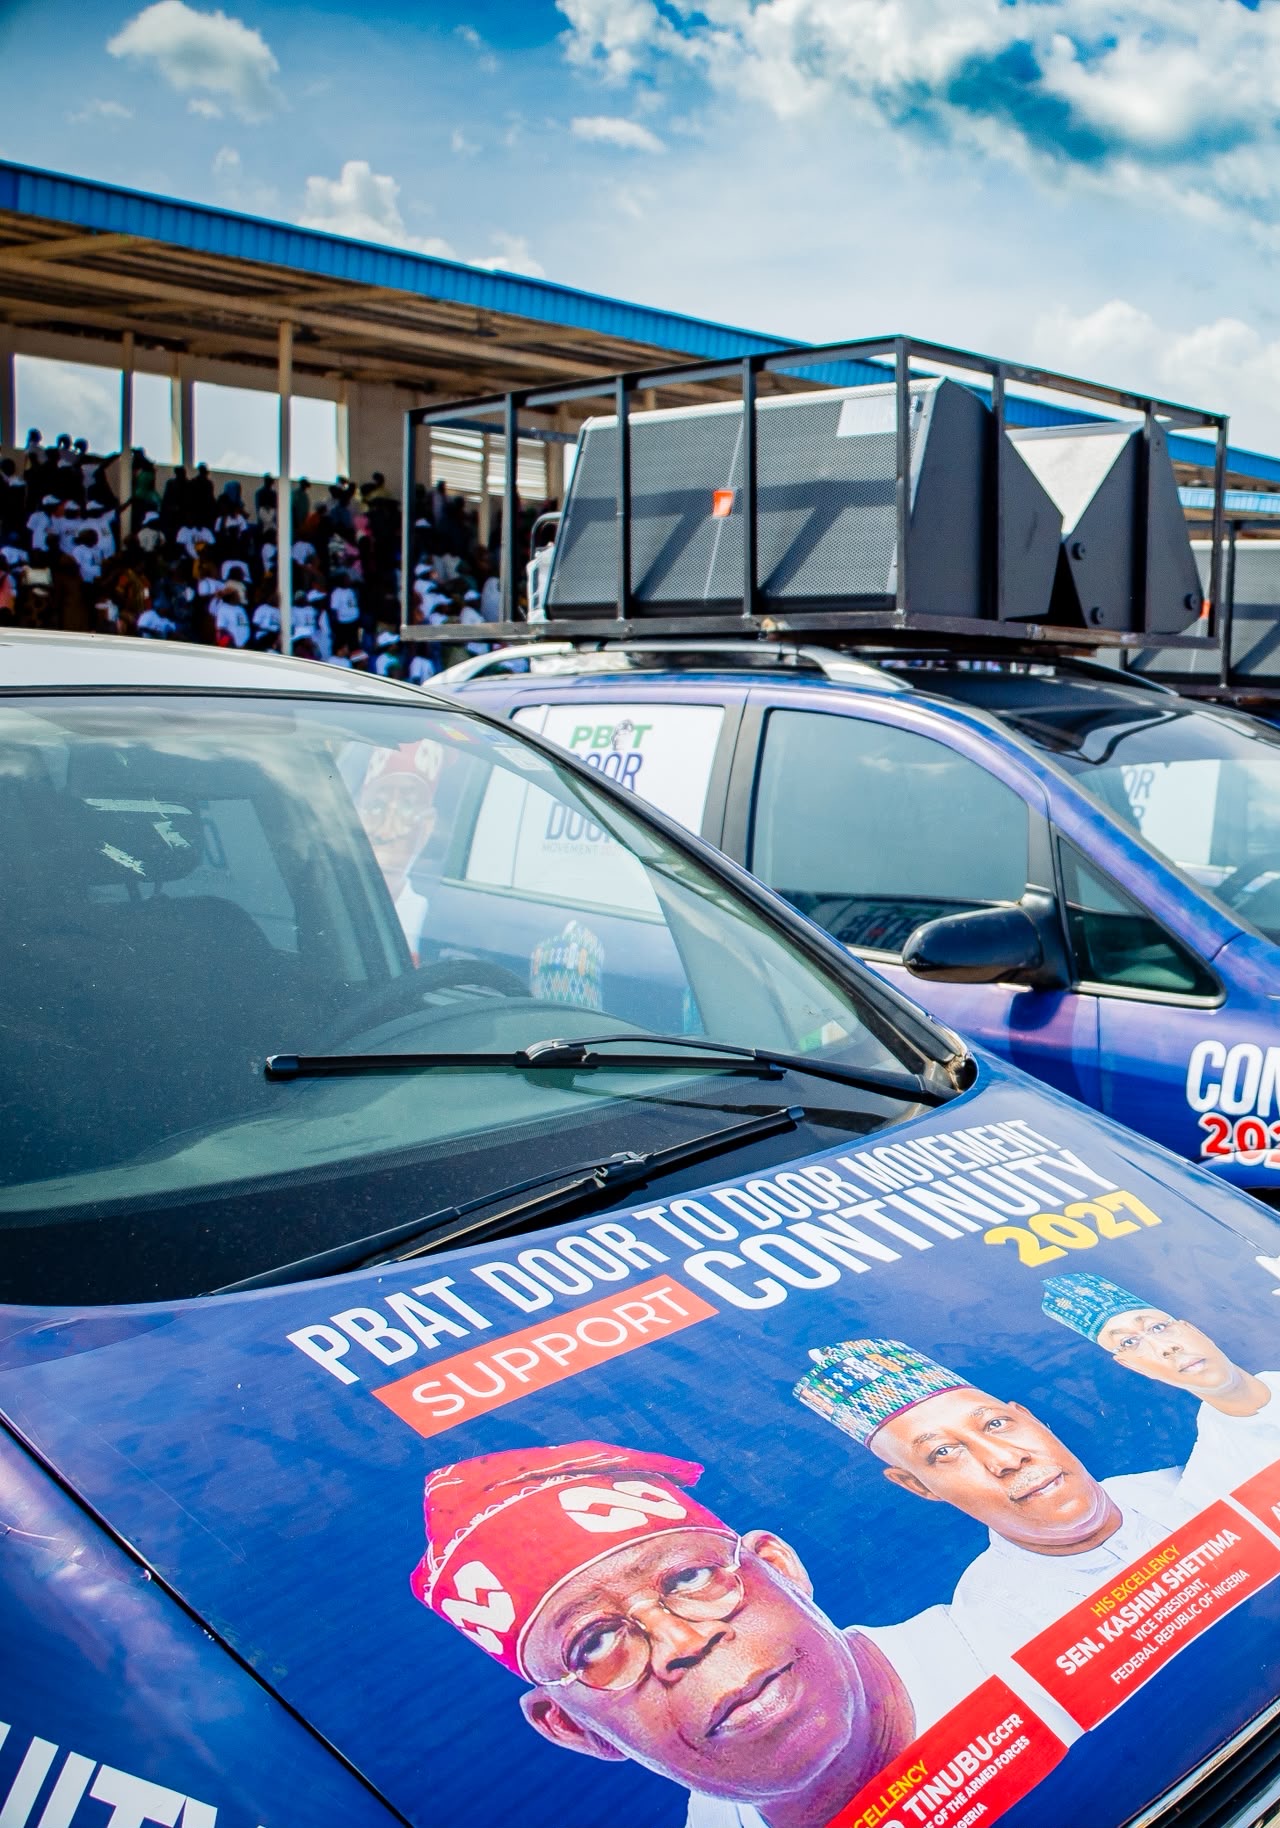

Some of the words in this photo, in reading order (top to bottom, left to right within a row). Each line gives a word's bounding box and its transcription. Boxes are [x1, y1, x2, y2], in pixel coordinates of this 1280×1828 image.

[569, 721, 653, 749] PBT
[286, 1276, 493, 1385] PBAT
[471, 1223, 671, 1314] DOOR
[632, 1199, 739, 1250] TO
[710, 1165, 865, 1230] DOOR
[837, 1119, 1062, 1193] MOVEMENT
[984, 1190, 1163, 1267] 2027
[412, 1287, 691, 1418] SUPPORT
[684, 1149, 1120, 1310] CONTINUITY
[1055, 1636, 1105, 1675] SEN.
[1097, 1582, 1168, 1643] KASHIM
[1161, 1528, 1242, 1590] SHETTIMA
[1090, 1595, 1116, 1618] HIS
[1111, 1544, 1181, 1602] EXCELLENCY
[1131, 1617, 1158, 1642] VICE
[1155, 1578, 1209, 1624] PRESIDENT,
[1110, 1643, 1159, 1684] FEDERAL
[1155, 1604, 1203, 1646] REPUBLIC
[1200, 1597, 1214, 1609] OF
[1212, 1569, 1250, 1600] NIGERIA
[853, 1760, 929, 1828] CELLENCY
[933, 1808, 949, 1826] OF
[946, 1792, 968, 1814] THE
[965, 1765, 998, 1797] ARMED
[993, 1735, 1031, 1769] FORCES
[953, 1802, 989, 1828] GERIA
